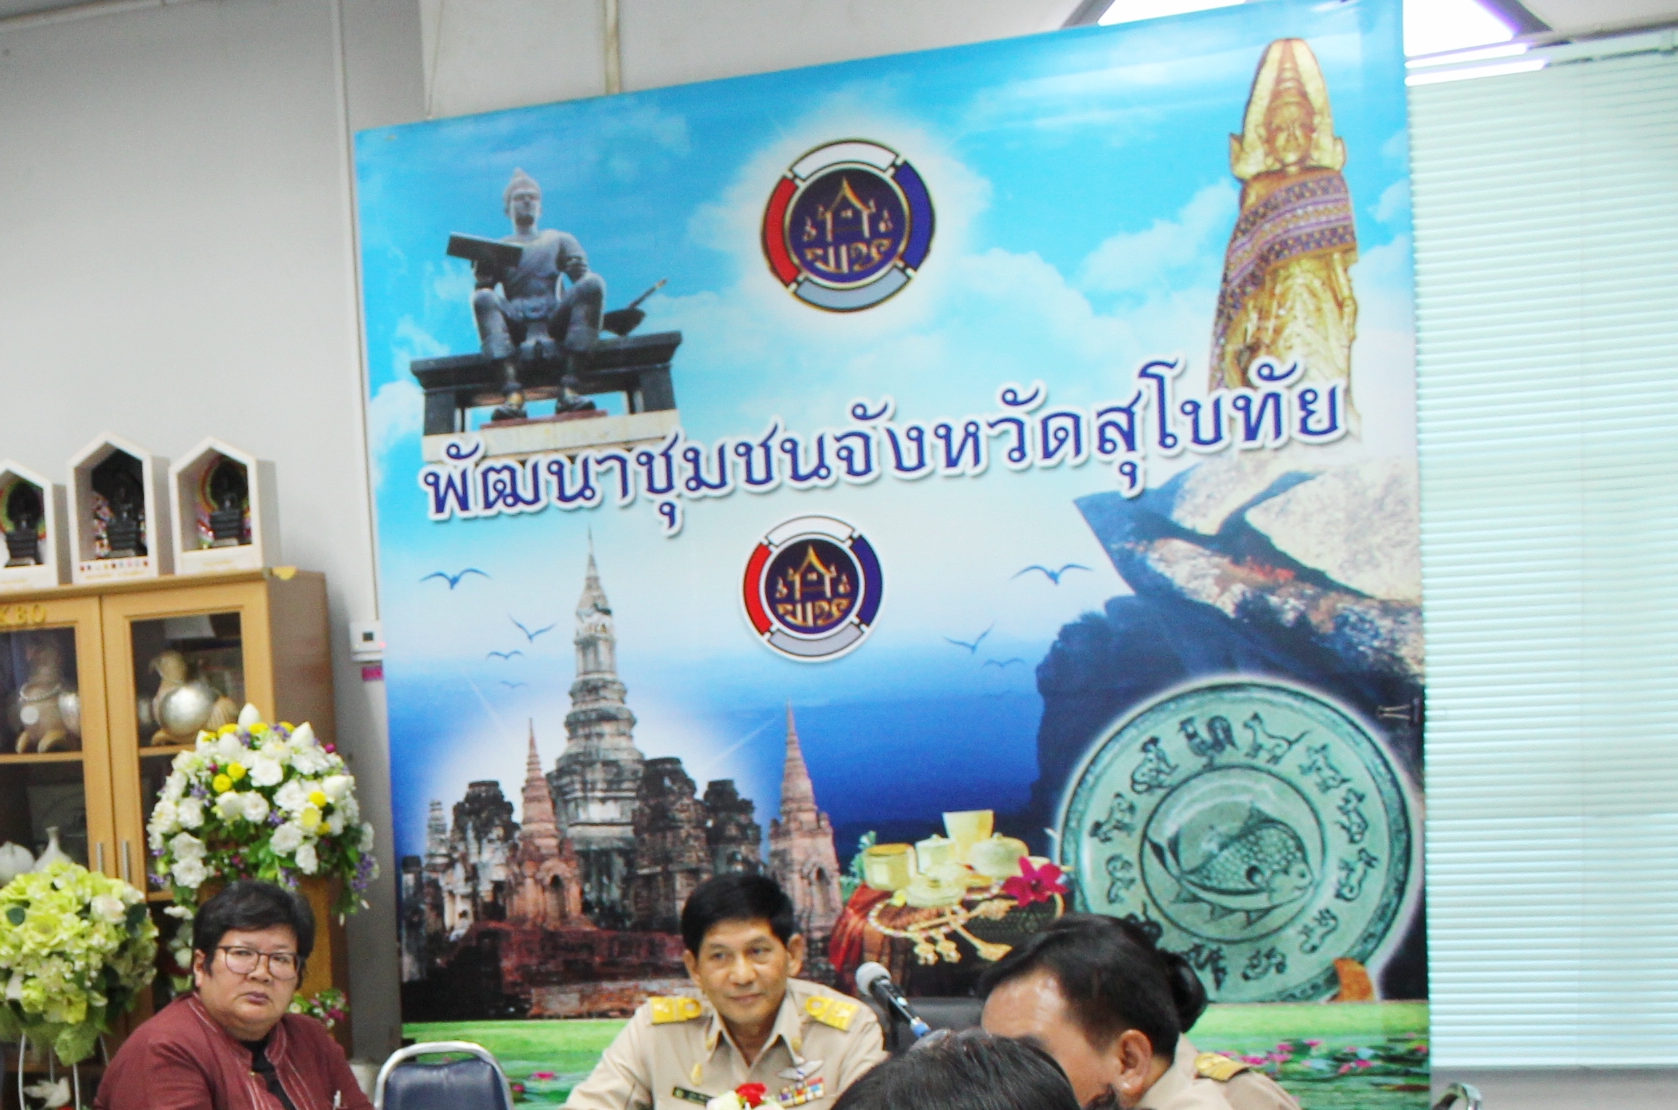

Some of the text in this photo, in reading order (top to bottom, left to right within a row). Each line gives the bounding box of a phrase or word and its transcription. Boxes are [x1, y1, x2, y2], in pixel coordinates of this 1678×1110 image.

[423, 359, 1340, 530] พัฒนาชุมชนจังหวัดสุโขทัย
